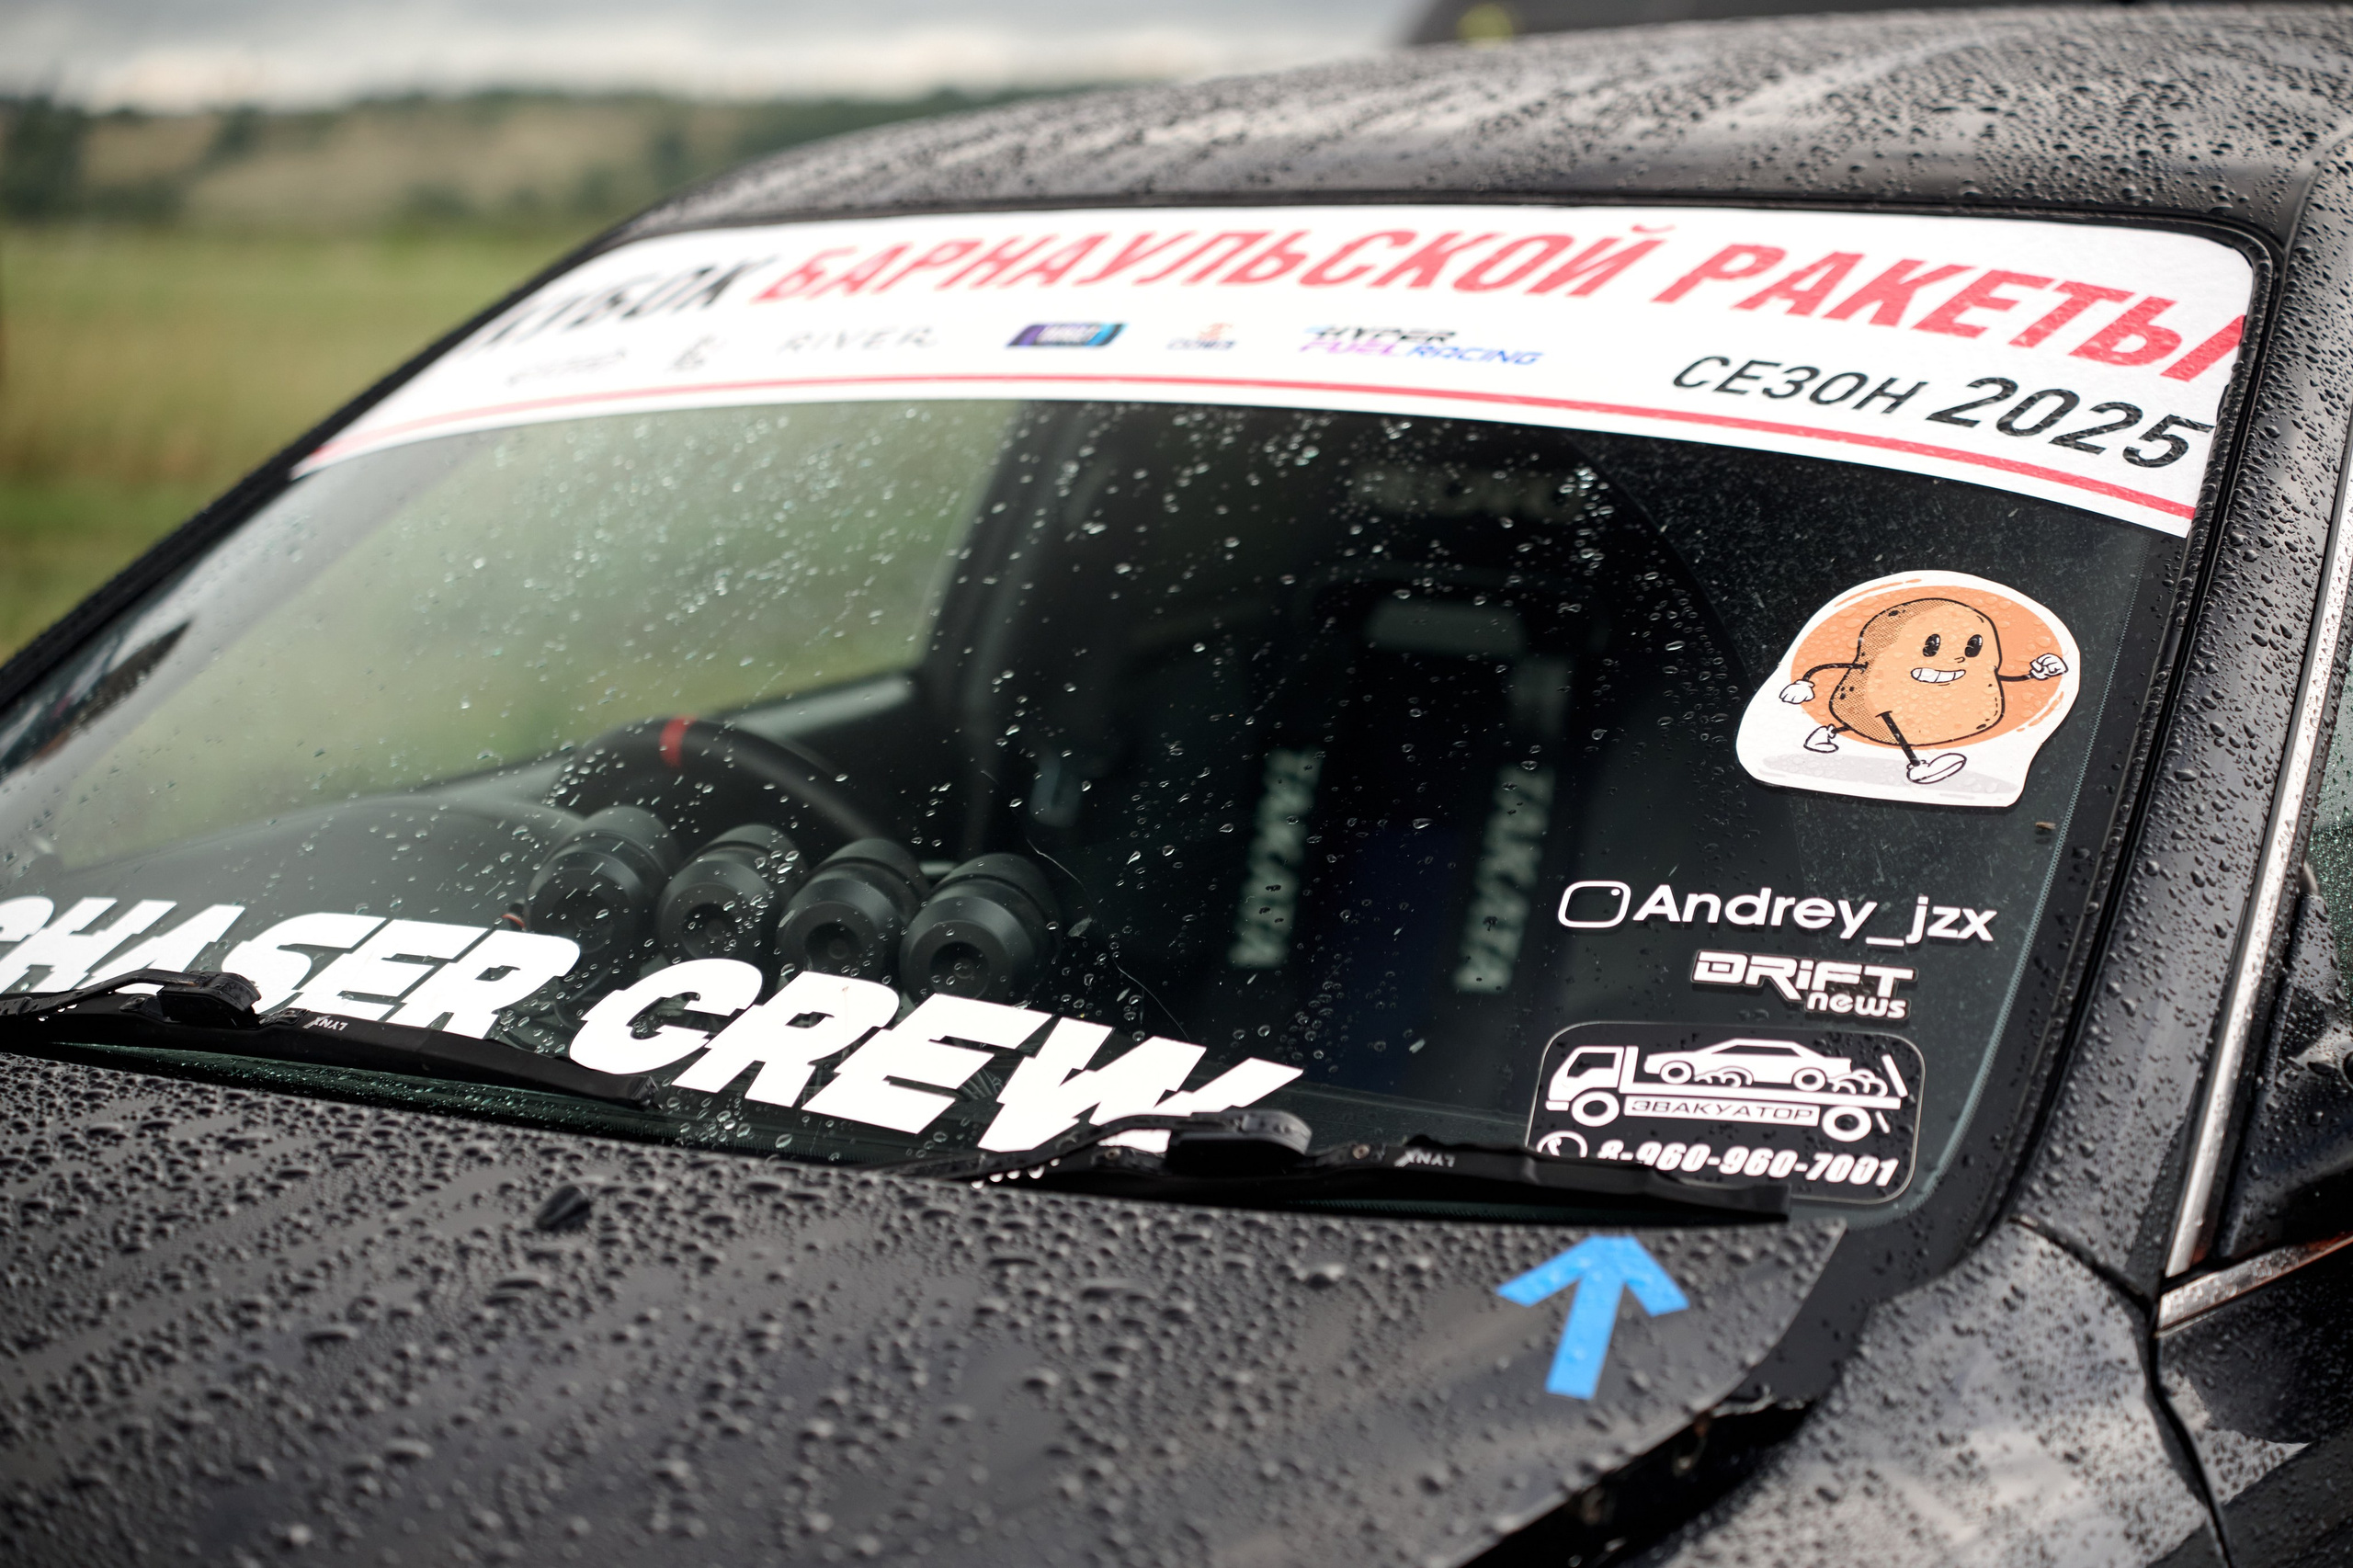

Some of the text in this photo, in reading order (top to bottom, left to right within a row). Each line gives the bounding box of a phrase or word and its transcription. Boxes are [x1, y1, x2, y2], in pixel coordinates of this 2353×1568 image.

[748, 223, 1677, 304] БАРНАУЛЬСКОЙ
[1650, 242, 2246, 383] РАКЕТЫ
[1406, 343, 1544, 366] RACING
[1672, 355, 2217, 470] СЕЗОН 2025
[1632, 883, 1998, 948] Andrey_jzx
[1805, 991, 1908, 1020] news
[569, 957, 1304, 1154] CREW
[1630, 1099, 1814, 1121] ЭВАКУАТОР
[1597, 1138, 1900, 1187] 8-960-960-7001
